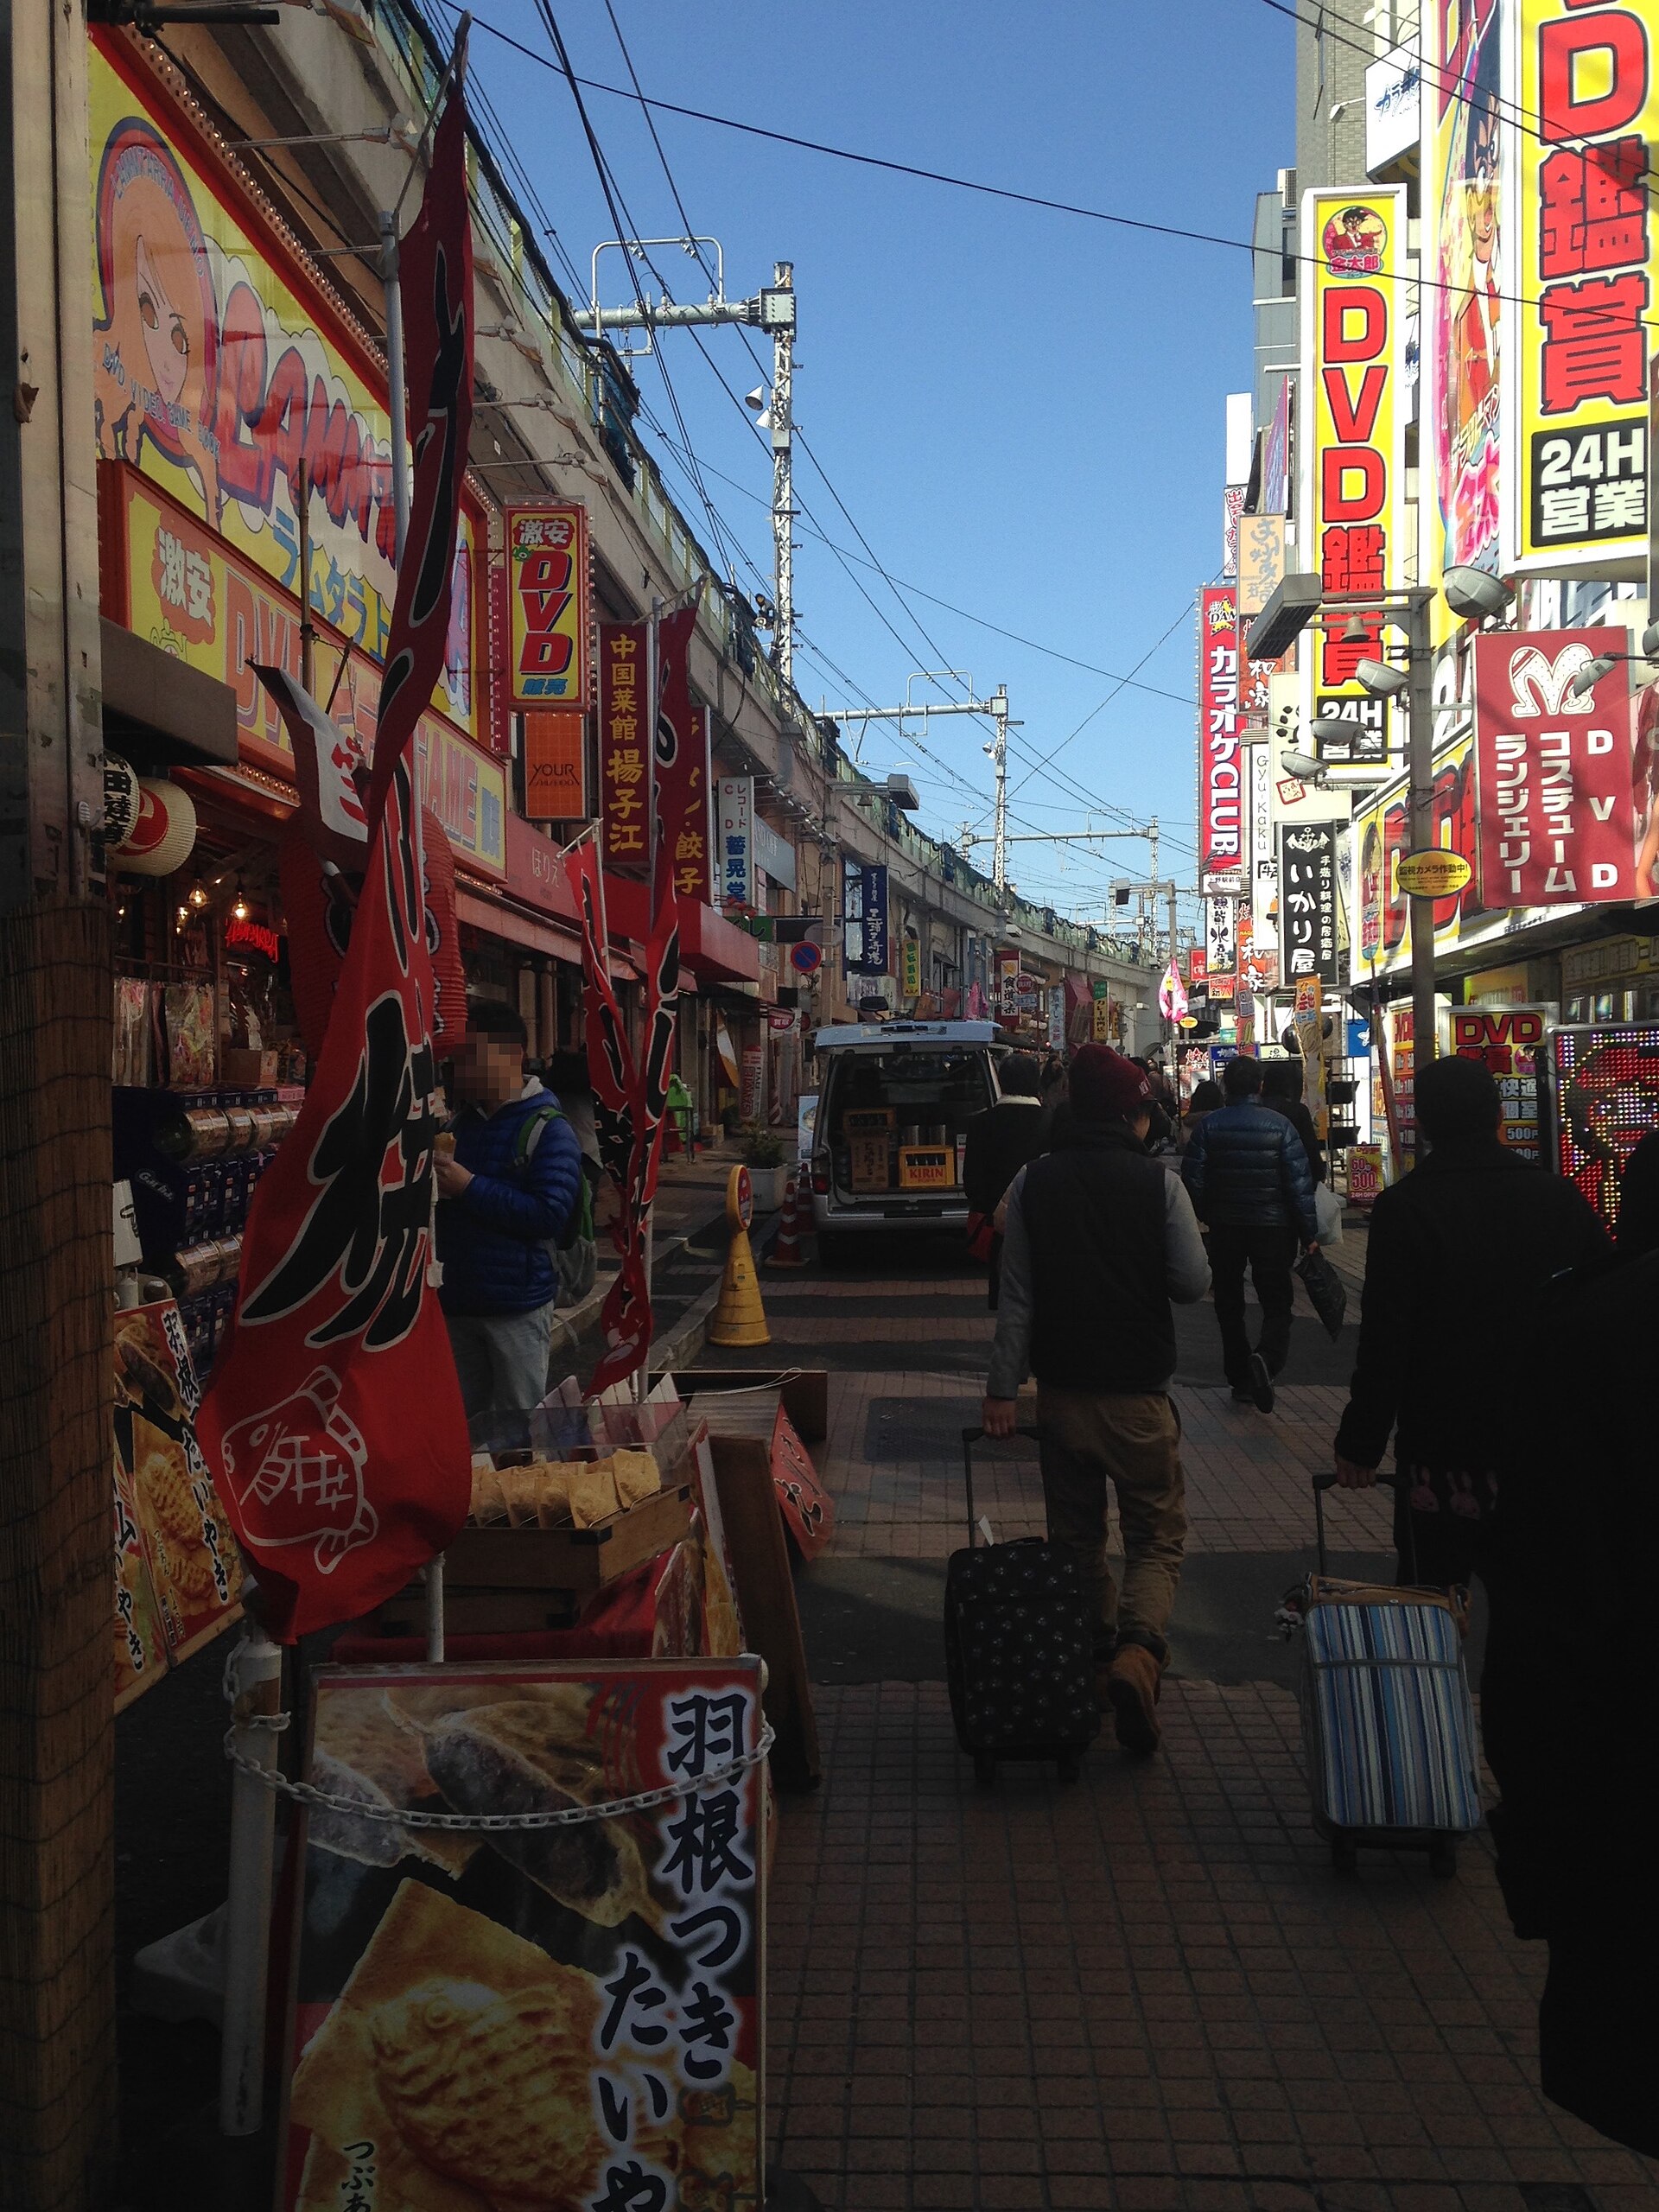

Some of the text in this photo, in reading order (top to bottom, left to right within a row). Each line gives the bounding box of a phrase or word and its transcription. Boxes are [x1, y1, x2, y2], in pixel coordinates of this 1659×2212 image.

[1331, 256, 1380, 273] 金太郎
[1541, 429, 1645, 495] 24H
[518, 520, 569, 544] 激安
[1542, 478, 1645, 538] 営業
[158, 529, 214, 629] 激安
[518, 550, 573, 676] DVD
[521, 678, 567, 695] 販売
[529, 763, 580, 785] YOUR
[607, 633, 645, 854] 中国菜館揚子江
[737, 784, 747, 830] レコード
[1256, 755, 1269, 850] Gyu-Kaku
[1495, 733, 1531, 893] ランジェリー
[1539, 731, 1578, 893] コスチューム
[1585, 729, 1618, 889] DVD
[674, 830, 705, 896] 餃子
[1400, 864, 1469, 876] 監視カメラ作動中!
[1287, 863, 1316, 974] いかり屋
[1455, 1014, 1542, 1046] DVD
[909, 1167, 944, 1179] KIRIN
[664, 1693, 753, 2081] 羽根つき
[592, 1952, 669, 2212] たいや
